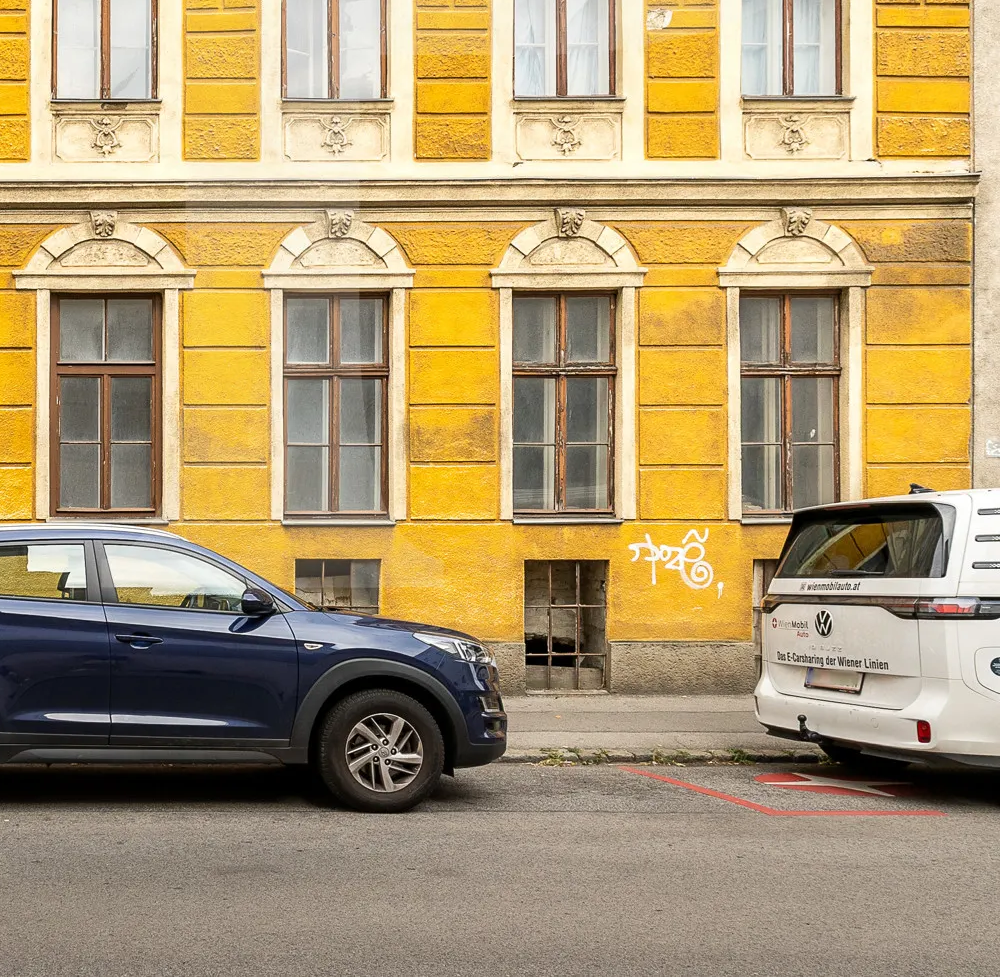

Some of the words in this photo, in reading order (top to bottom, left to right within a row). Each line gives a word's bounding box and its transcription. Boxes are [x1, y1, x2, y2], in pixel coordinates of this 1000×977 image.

[806, 581, 861, 592] wienmobilauto.at
[778, 620, 809, 629] WienMobil
[776, 651, 786, 662] Das
[787, 652, 824, 667] E-Carsharing
[825, 655, 836, 666] der
[837, 656, 862, 668] Wiener
[864, 658, 889, 670] Linien
